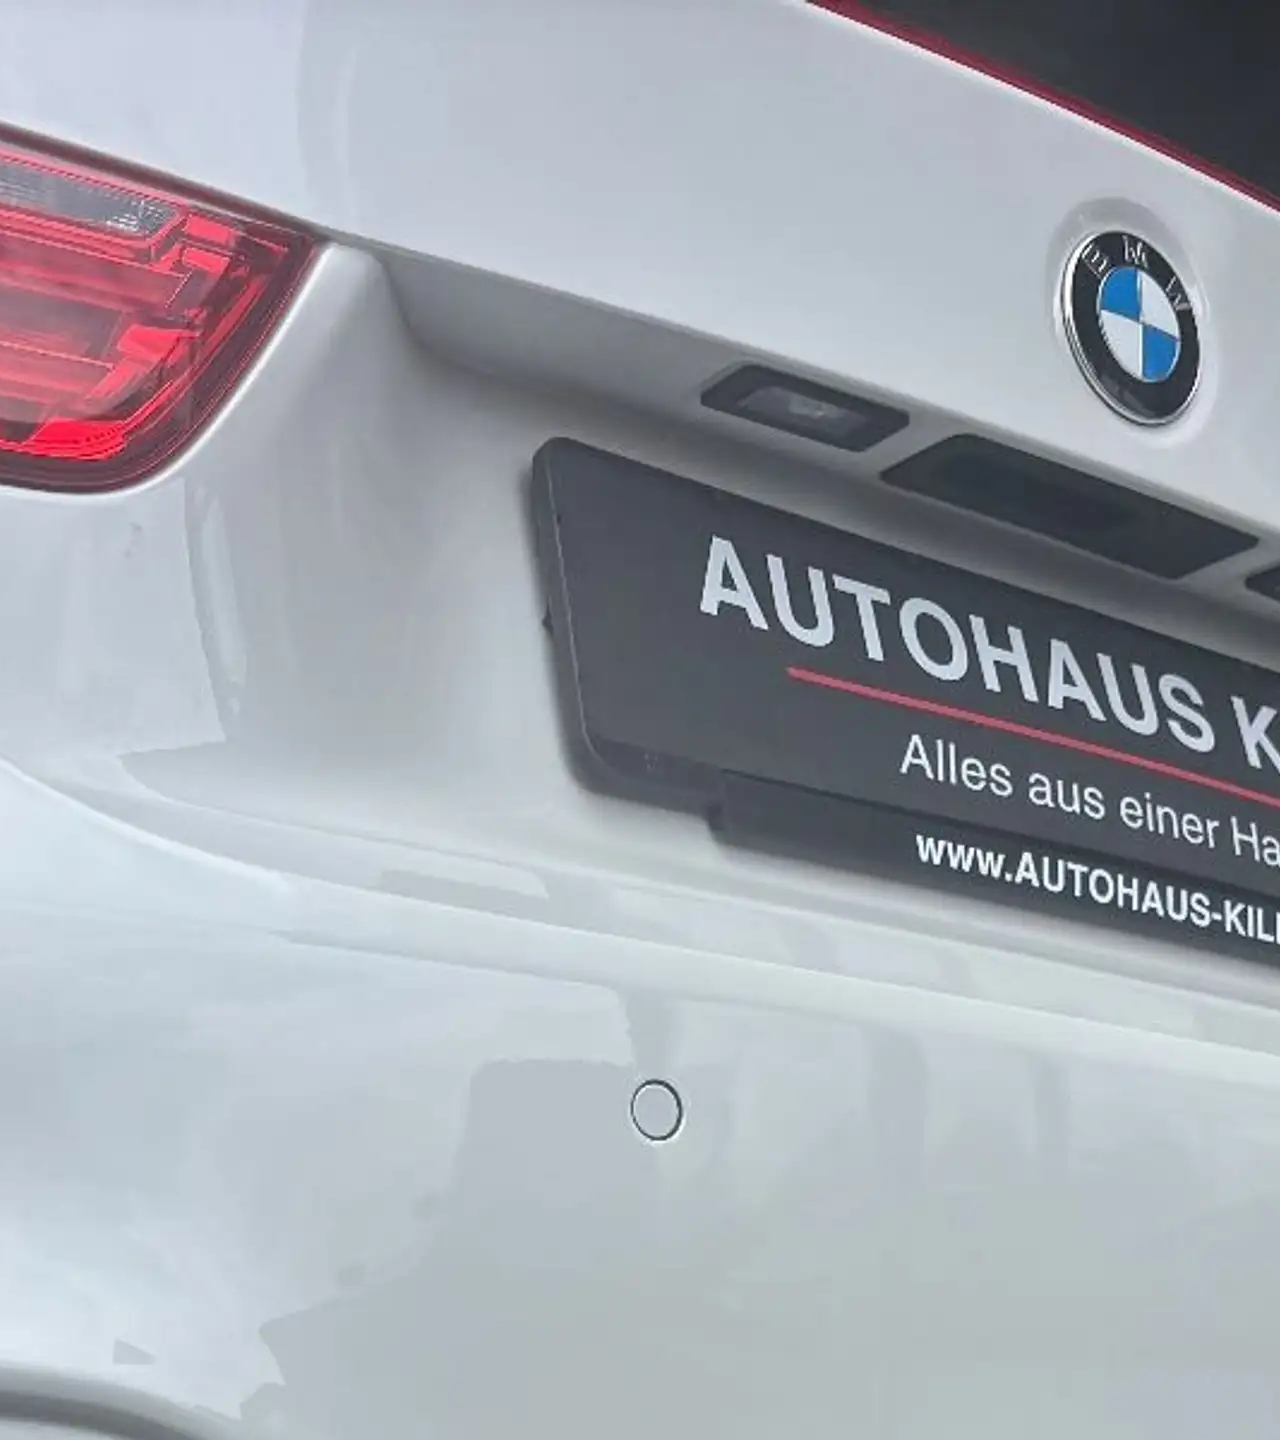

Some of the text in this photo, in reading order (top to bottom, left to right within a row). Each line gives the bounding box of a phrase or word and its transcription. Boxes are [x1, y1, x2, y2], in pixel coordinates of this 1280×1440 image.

[1081, 236, 1193, 312] BMW
[700, 534, 1216, 753] AUTOHAUS
[900, 734, 1013, 797] Alles
[1028, 772, 1106, 820] aus
[1119, 792, 1220, 849] einer
